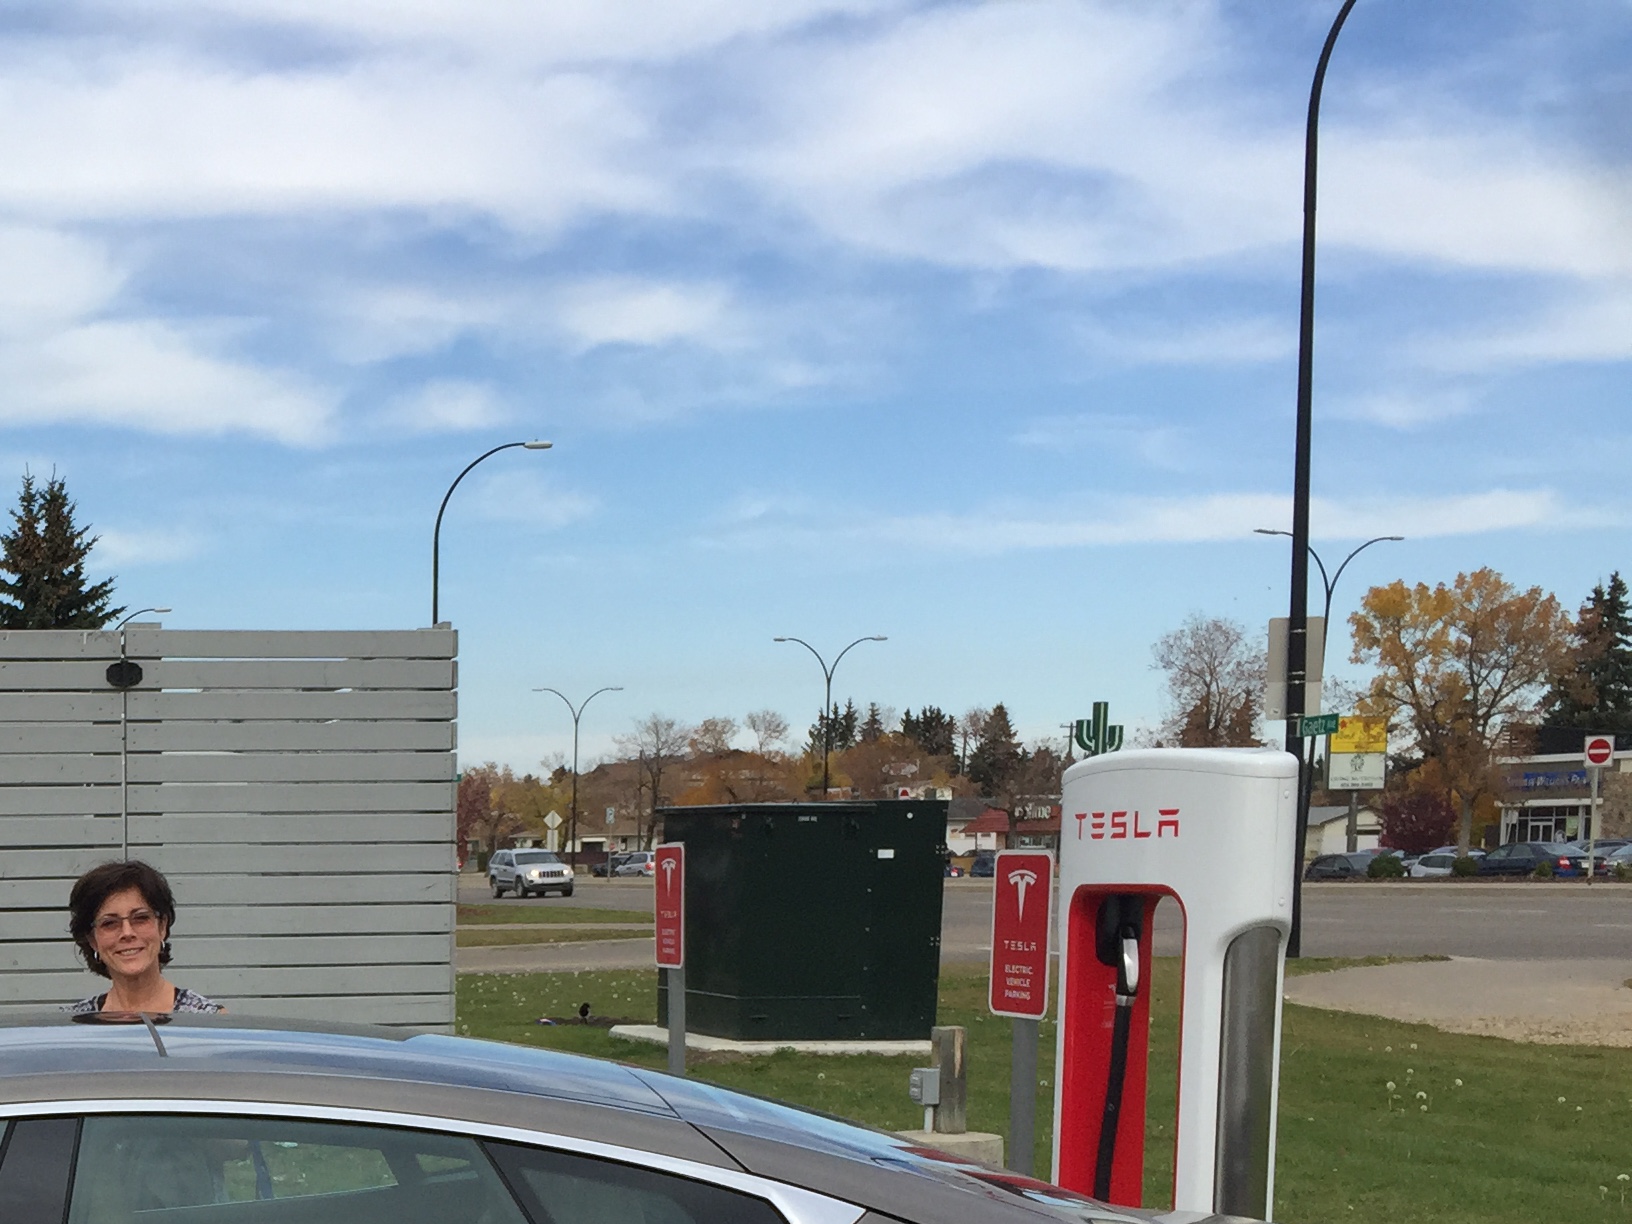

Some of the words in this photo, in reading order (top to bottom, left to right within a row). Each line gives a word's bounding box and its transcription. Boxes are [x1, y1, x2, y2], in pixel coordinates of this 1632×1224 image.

[1302, 718, 1326, 736] Gaetz
[1074, 808, 1180, 840] TESLA
[1003, 939, 1037, 952] TESLA
[1004, 963, 1034, 976] ELECTRIC
[1005, 976, 1031, 988] VEHICLE
[1004, 989, 1031, 1001] PARKING
